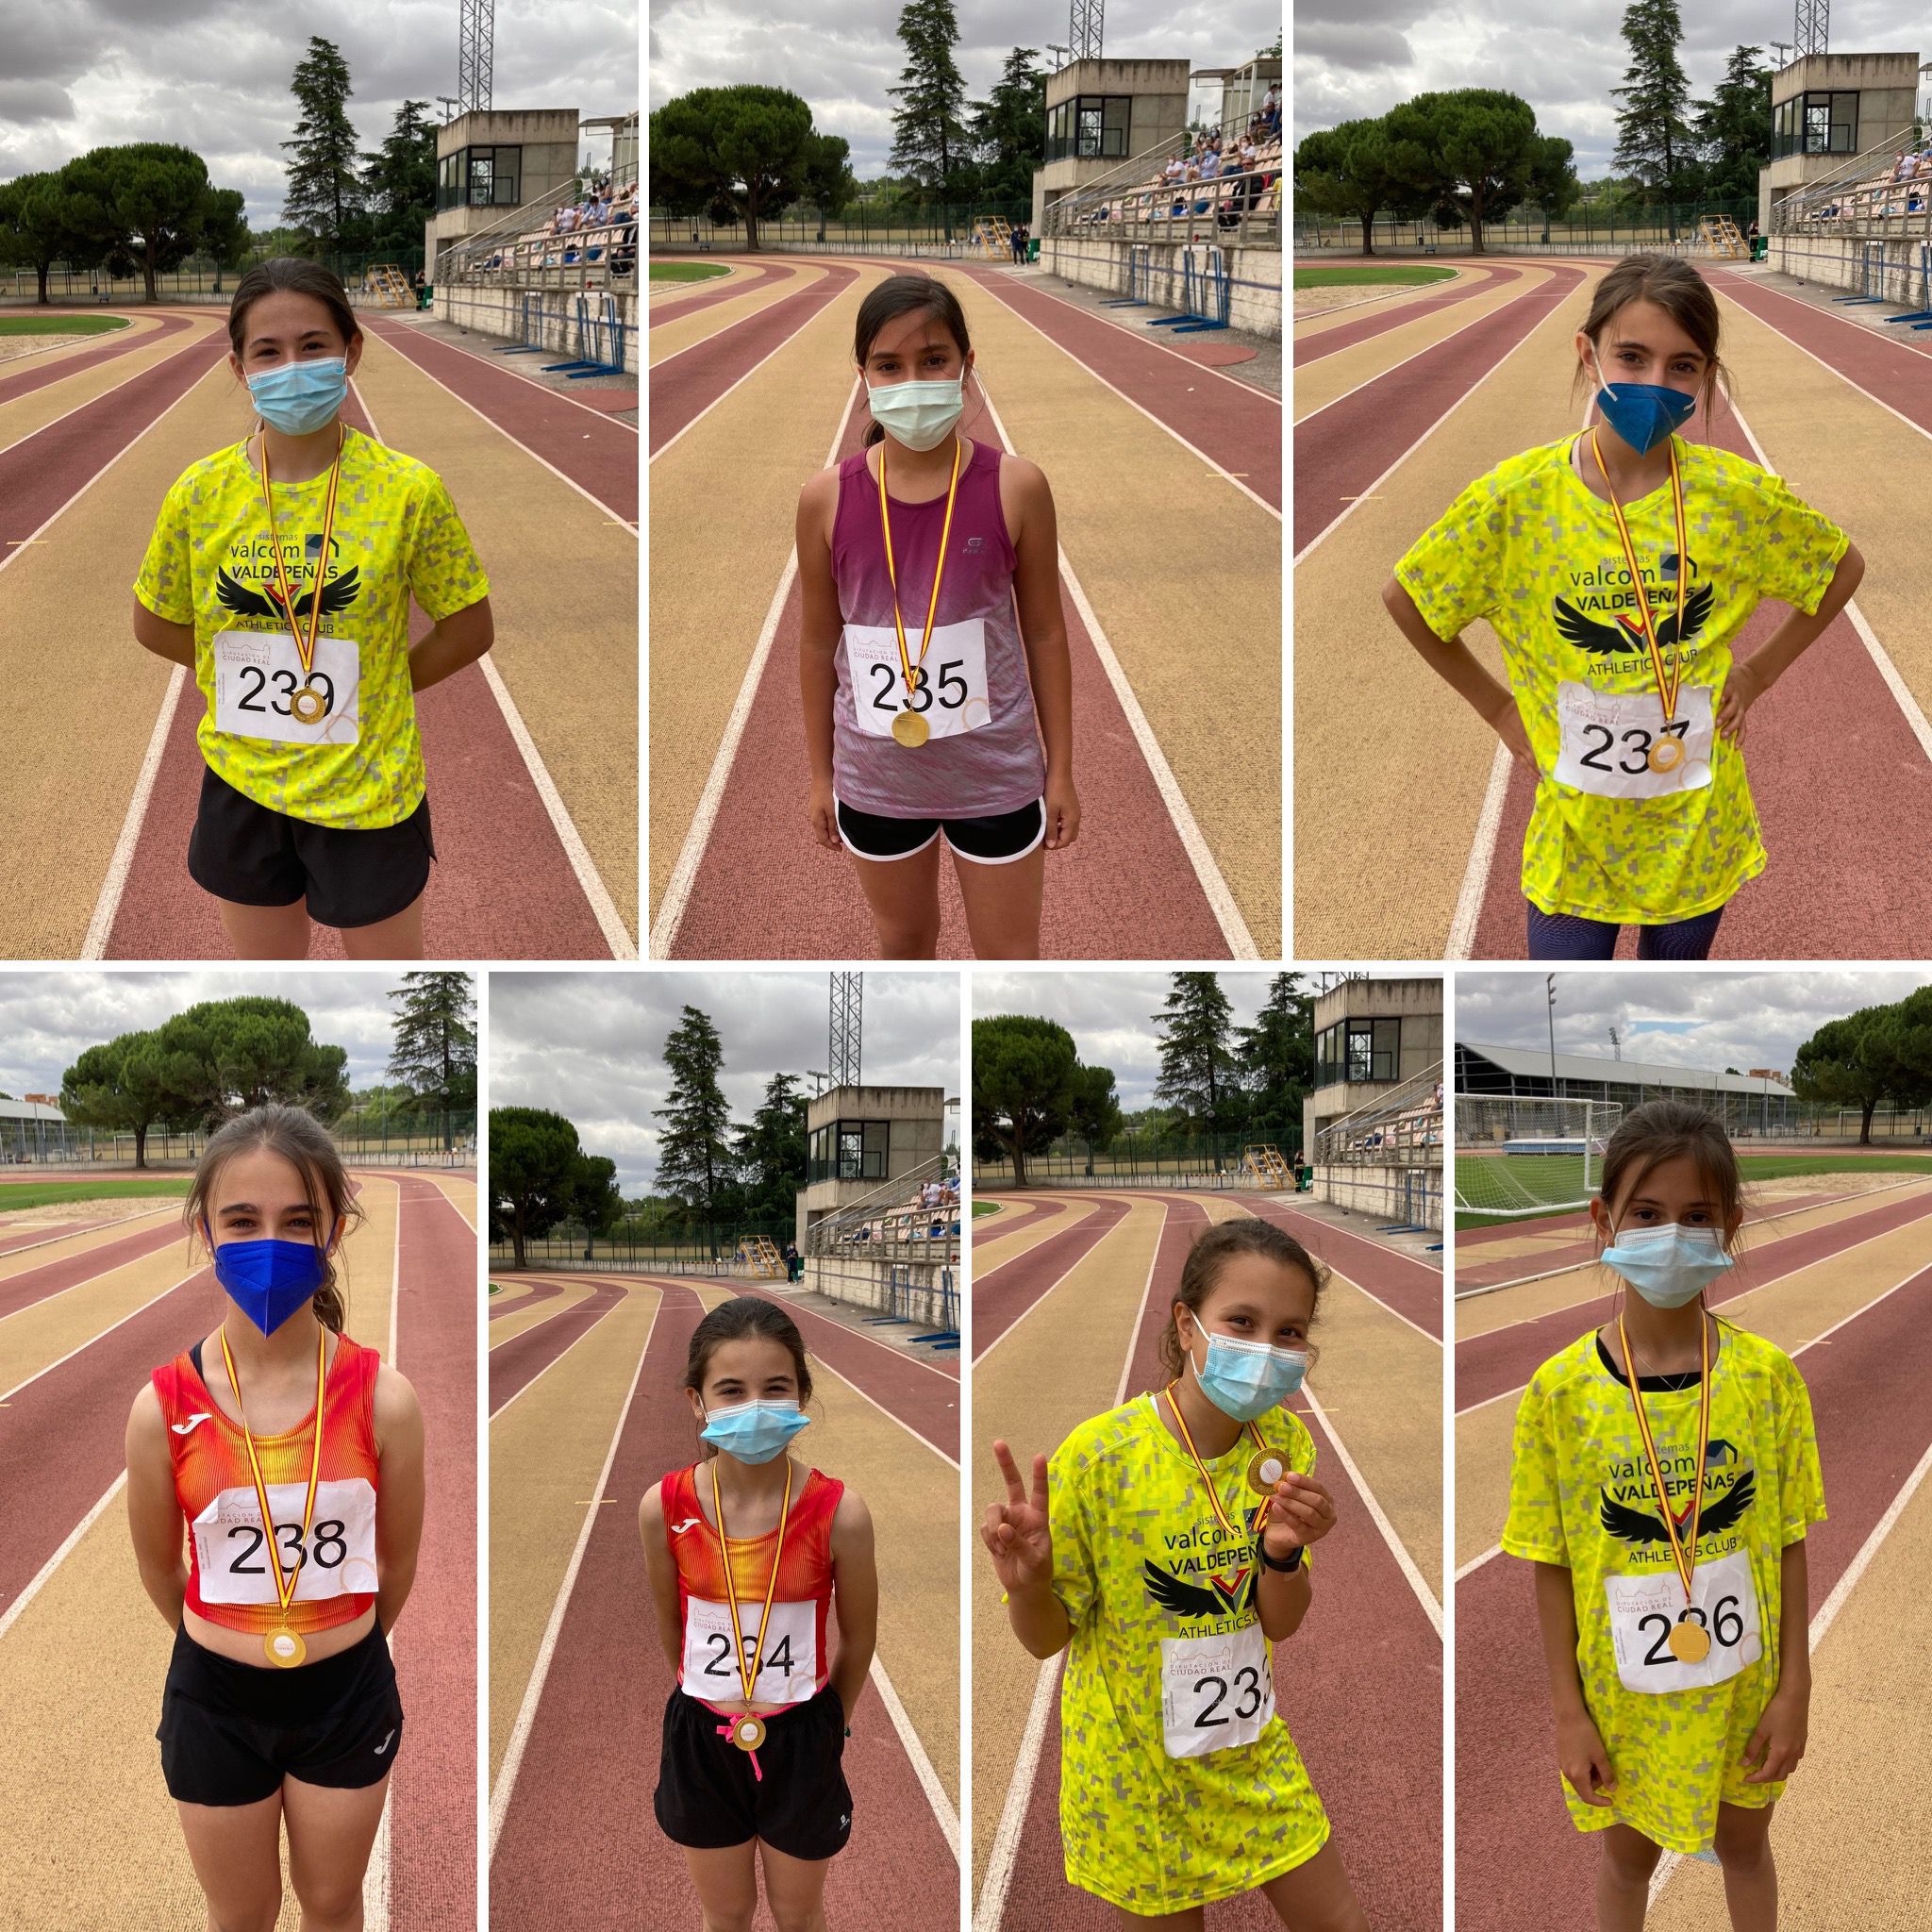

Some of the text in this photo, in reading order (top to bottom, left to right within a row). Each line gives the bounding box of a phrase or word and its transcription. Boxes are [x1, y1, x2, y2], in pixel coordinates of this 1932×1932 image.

[230, 541, 300, 558] valcom
[1603, 555, 1651, 565] sisteas
[1570, 565, 1656, 587] valcom
[1575, 587, 1696, 611] VALDEEÑS
[236, 620, 334, 634] ATHLETIC CUB
[853, 651, 879, 660] CIUDAD
[1588, 648, 1698, 675] ATHLETIC CUB
[238, 665, 335, 718] 239
[870, 658, 968, 713] 235
[1580, 718, 1690, 774] 237
[1642, 1442, 1690, 1455] temas
[1608, 1457, 1696, 1479] valcom
[1196, 1511, 1236, 1526] sisteas
[227, 1519, 347, 1574] 238
[1164, 1524, 1243, 1550] valcom
[1168, 1541, 1258, 1575] VALDEPEÑ
[1628, 1537, 1738, 1564] ATHLECS CLUB
[1651, 1602, 1674, 1611] REAL
[693, 1622, 717, 1631] CIUDAD
[1179, 1613, 1252, 1640] ATHLETICS
[704, 1632, 795, 1677] 234
[1170, 1664, 1231, 1676] CIUDAD REAL
